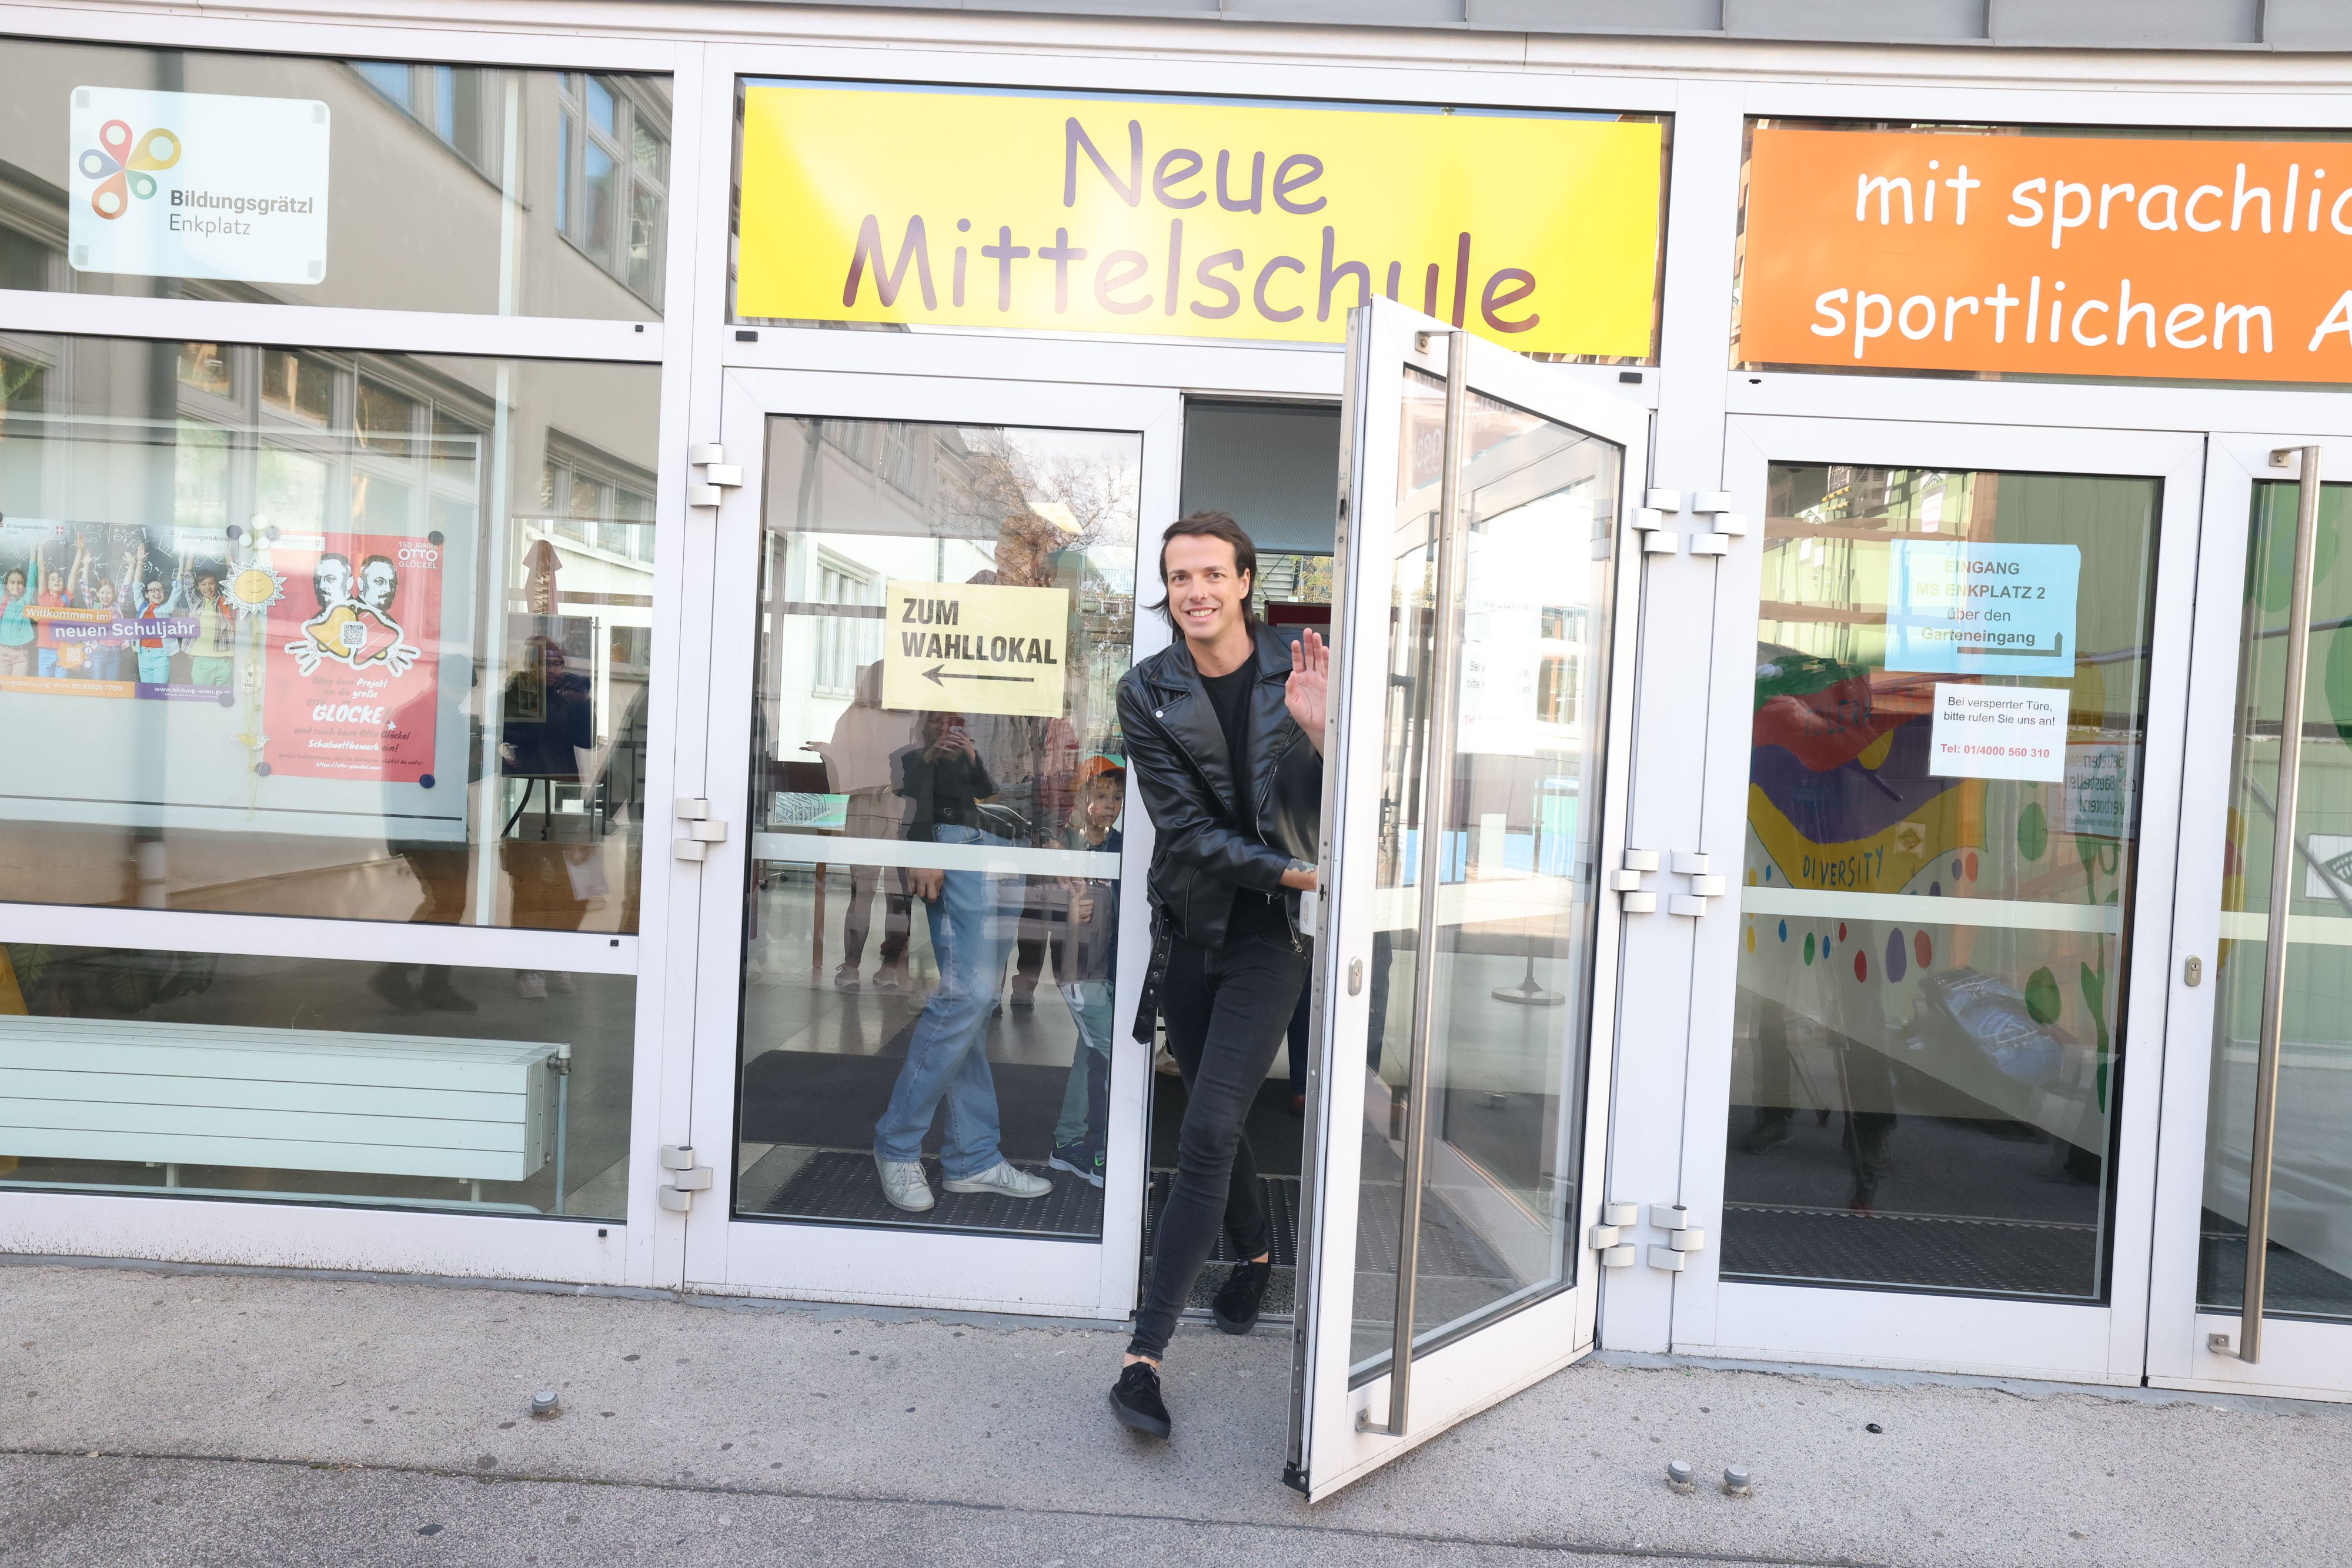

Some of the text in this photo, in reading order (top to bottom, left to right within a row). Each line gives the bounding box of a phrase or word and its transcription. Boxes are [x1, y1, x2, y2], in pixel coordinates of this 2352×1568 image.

[1063, 116, 1328, 215] Neue
[1856, 159, 1981, 226] mit
[170, 189, 313, 215] Bildungsgrätzl
[169, 213, 252, 238] Enkplatz
[843, 213, 1541, 333] Mittelschule
[1810, 276, 2273, 359] sportlichem
[398, 548, 438, 562] OTTO
[399, 559, 437, 569] GLÖCKEL
[1945, 560, 2020, 575] EINGANG
[1916, 582, 2046, 599] MS ENKPLATZ 2
[26, 607, 108, 621] Willkommen im
[901, 597, 959, 626] ZUM
[1947, 607, 2011, 621] über den
[55, 621, 196, 638] neuen Schuljahr
[1921, 627, 2036, 646] Garteneingang
[901, 631, 1057, 664] WAHLLOKAL
[356, 678, 389, 689] Projekt
[352, 689, 378, 699] große
[1948, 697, 2052, 712] Bei versperrter Türe,
[1943, 712, 2055, 726] bitte rufen Sie uns an!
[380, 730, 411, 740] Glöckel
[308, 738, 399, 753] Schulwettbewerb ein!
[1940, 744, 2050, 758] Tel: 01/4000 560 310
[1803, 847, 1883, 888] DIVERSITY
